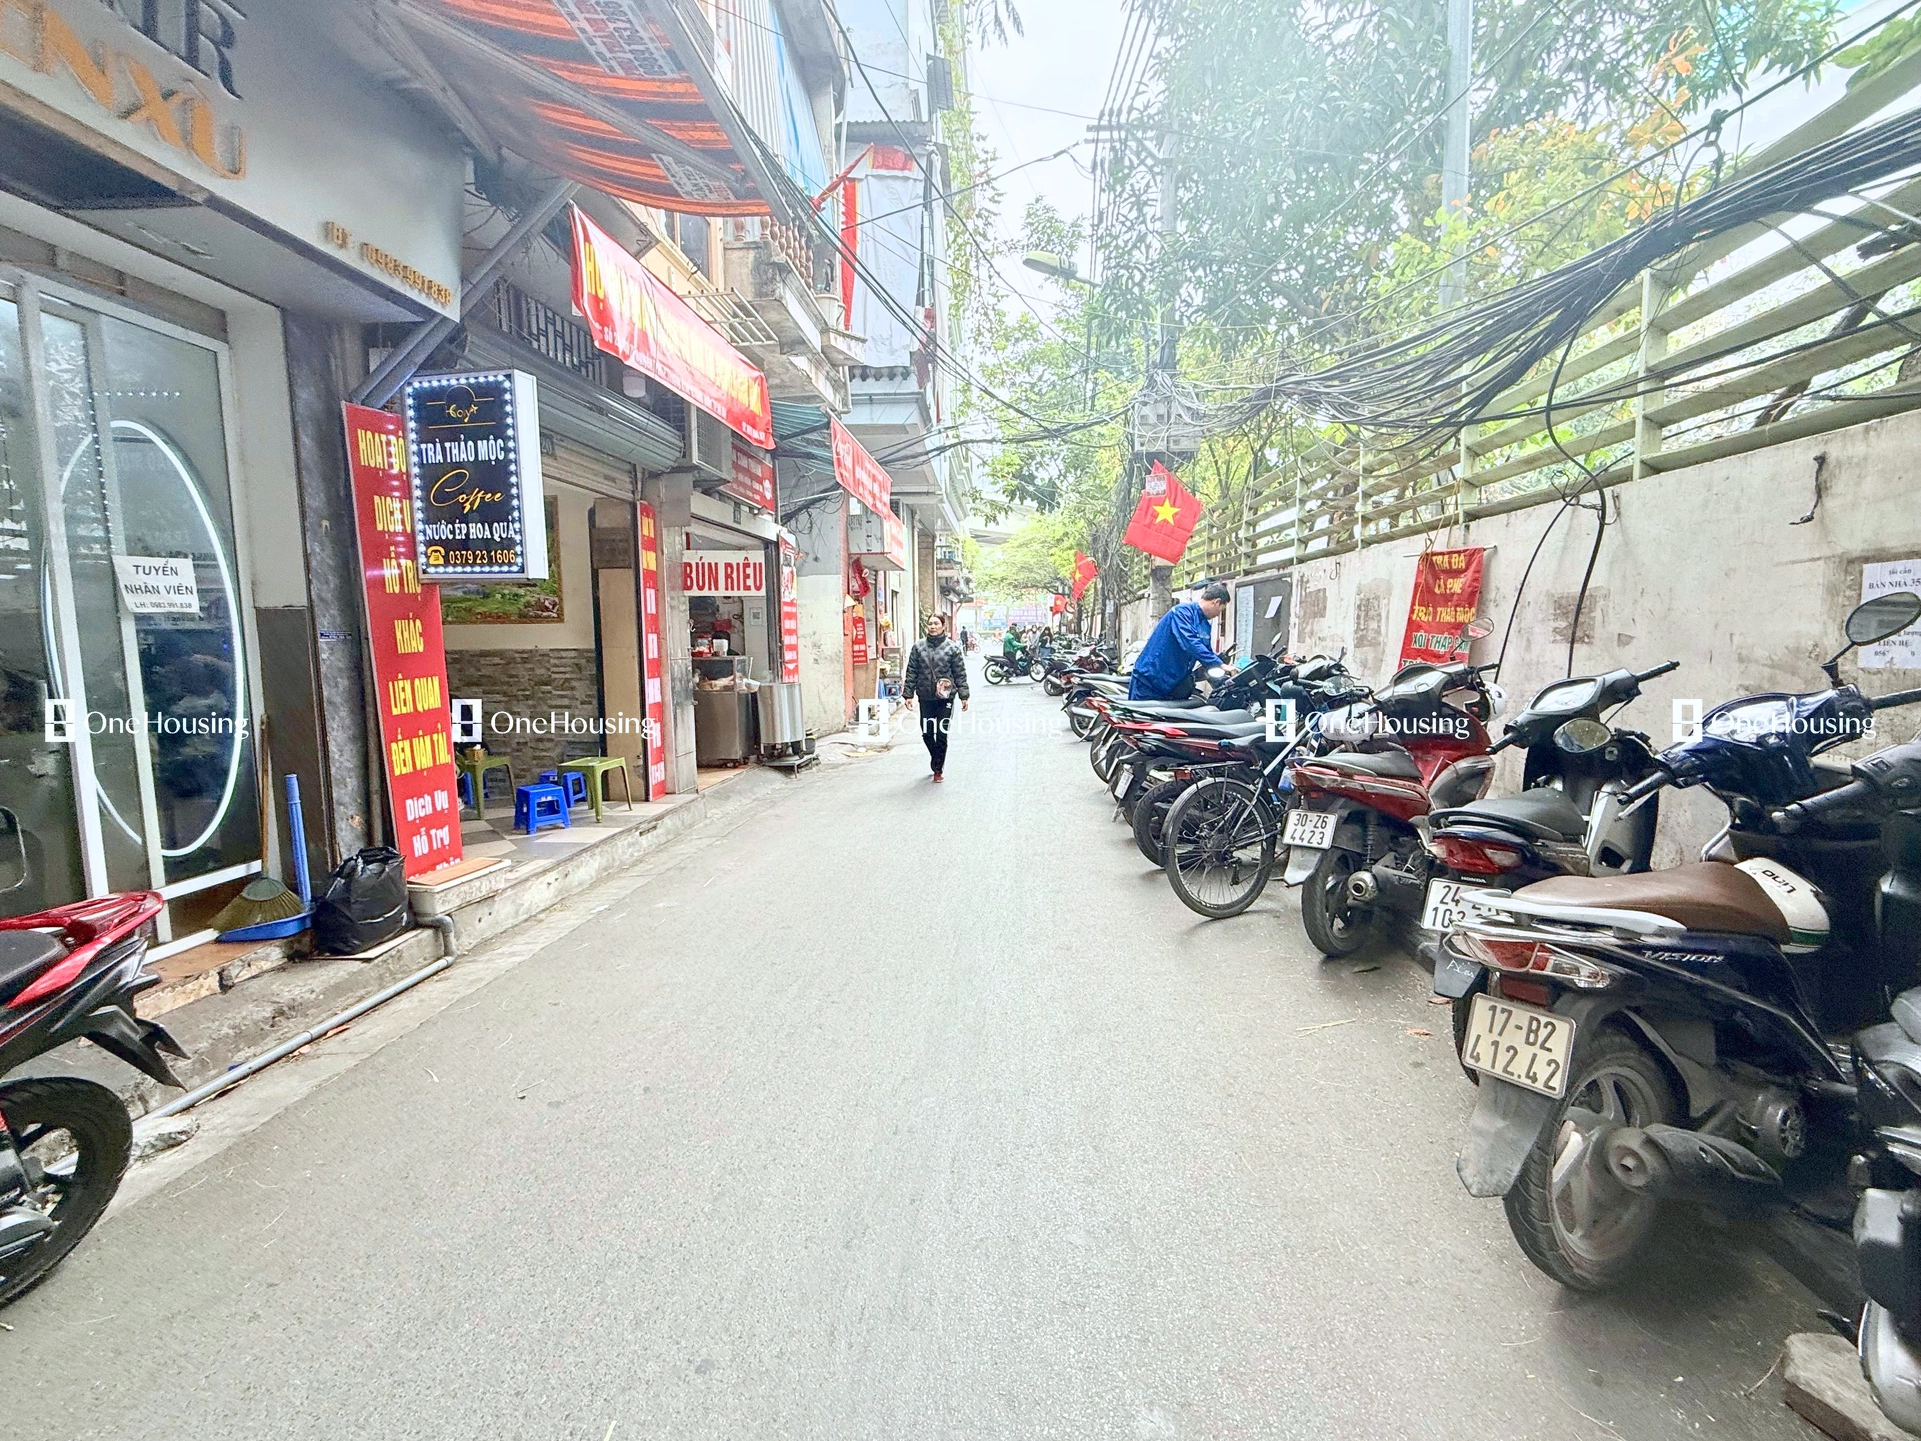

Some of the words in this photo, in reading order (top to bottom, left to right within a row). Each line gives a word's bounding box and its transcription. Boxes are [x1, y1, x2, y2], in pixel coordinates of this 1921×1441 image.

[357, 429, 389, 477] HOẠT
[420, 438, 444, 464] TRÀ
[444, 434, 475, 463] THẢO
[477, 434, 505, 465] MỘC
[430, 469, 506, 514] Coffee
[373, 495, 403, 539] DỊCH
[425, 519, 453, 540] NƯỚC
[454, 519, 468, 540] ÉP
[469, 522, 491, 539] HOA
[492, 515, 515, 542] QUẢ
[132, 559, 179, 577] TUYỂN
[383, 546, 400, 594] HỖ
[449, 550, 473, 564] 0379
[475, 550, 488, 564] 23
[490, 549, 516, 564] 1606
[124, 581, 161, 595] NHÂN
[164, 582, 194, 596] VIÊN
[683, 556, 719, 592] BÚN
[724, 556, 764, 592] RIÊU
[395, 612, 424, 654] KHÁC
[1411, 630, 1428, 649] XÔI
[1428, 632, 1454, 654] THẬP
[389, 673, 414, 716] LIÊN
[414, 676, 441, 713] QUAN
[390, 728, 414, 777] ĐẾN
[413, 730, 433, 776] VẬN
[405, 793, 433, 824] Dịch
[434, 789, 449, 814] Vụ
[1293, 812, 1329, 830] 30-Z6
[412, 826, 430, 858] Hỗ
[430, 824, 451, 851] Trợ
[1290, 828, 1325, 846] 4423
[1460, 875, 1487, 884] HONDA
[1641, 949, 1725, 963] VISION
[1488, 1004, 1557, 1053] 17-B2
[1469, 1033, 1561, 1092] 412.42
